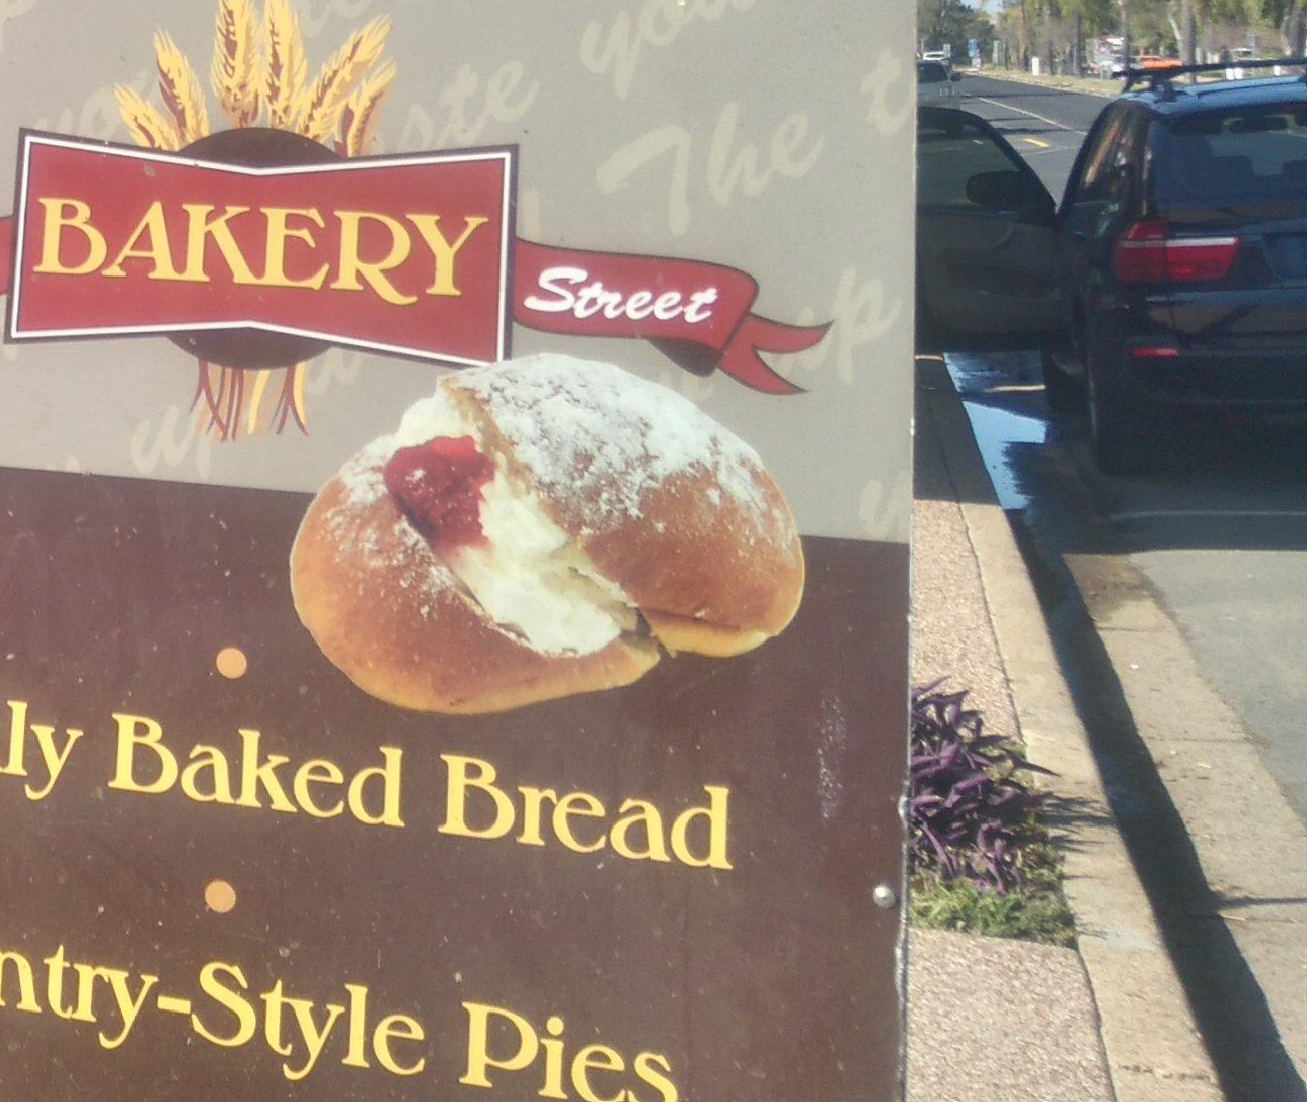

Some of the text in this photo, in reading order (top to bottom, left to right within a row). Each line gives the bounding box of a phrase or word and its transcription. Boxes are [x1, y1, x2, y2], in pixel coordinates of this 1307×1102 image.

[597, 101, 824, 236] The
[32, 197, 490, 307] BAKERY
[523, 266, 719, 325] Street
[107, 713, 405, 828] Baked
[437, 753, 734, 871] Bread
[459, 1000, 680, 1102] Pies
